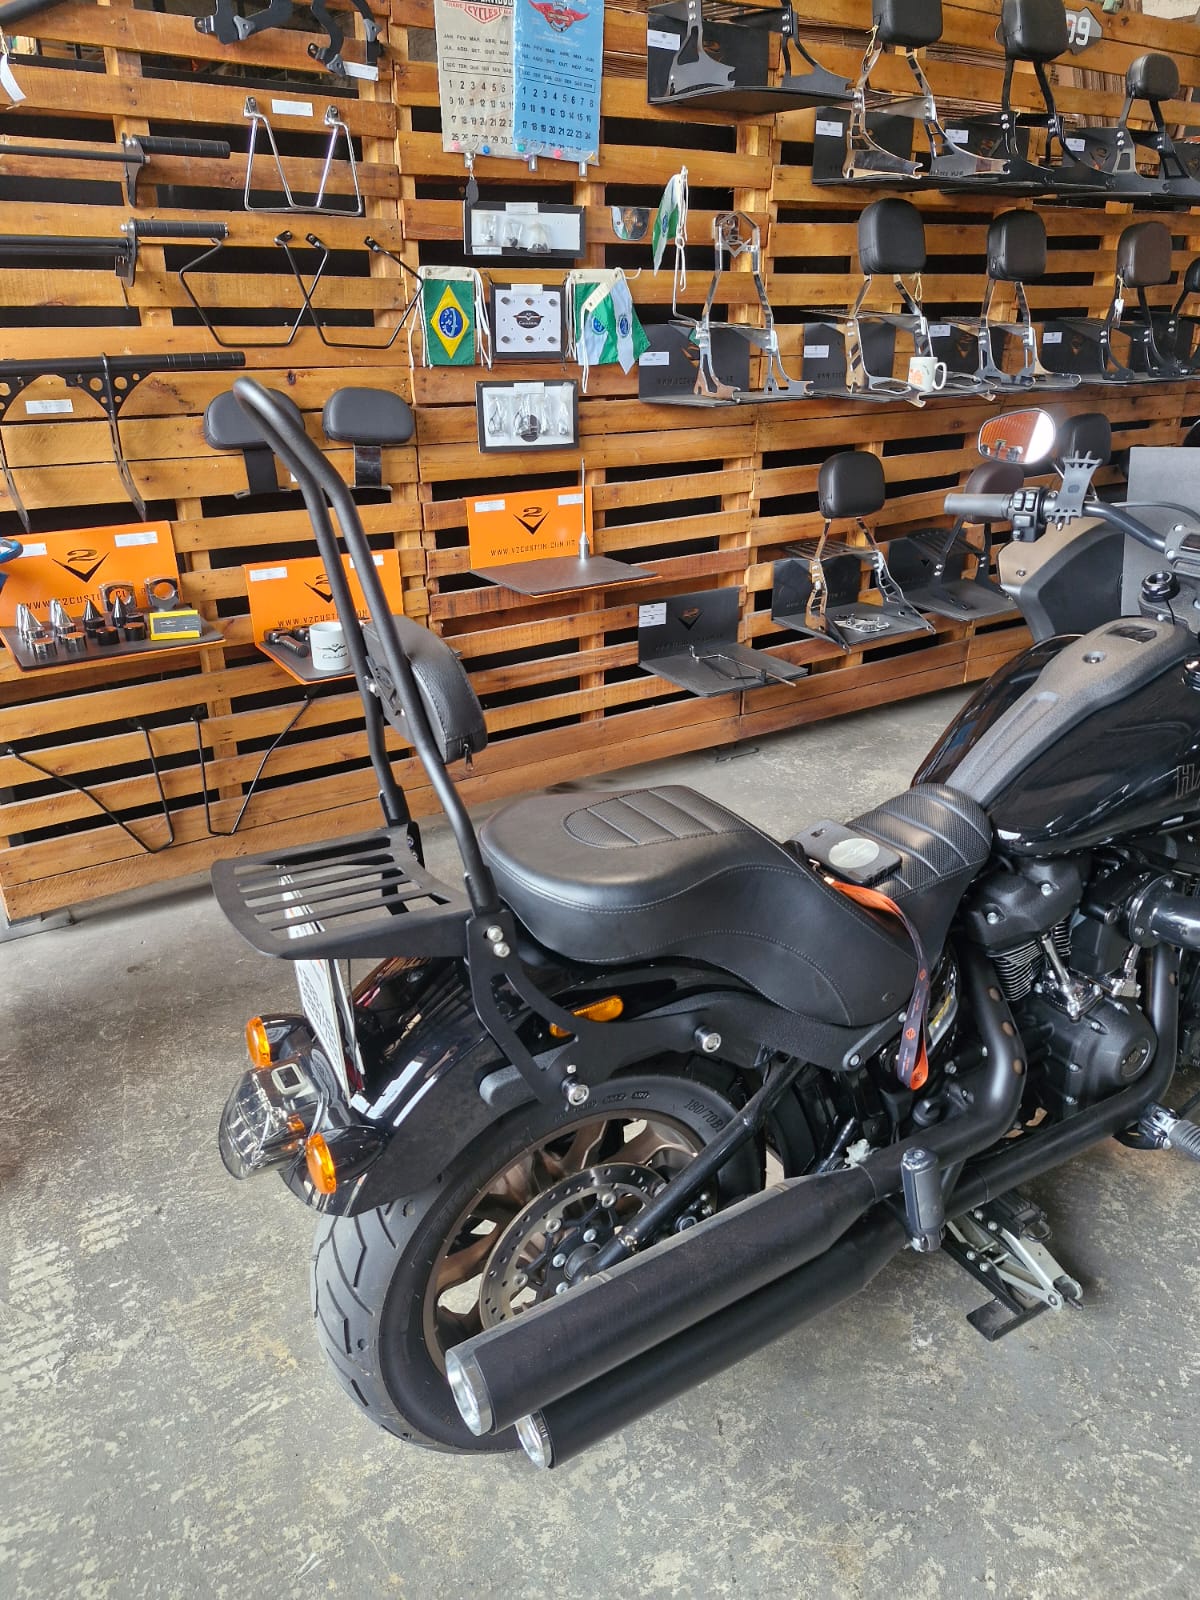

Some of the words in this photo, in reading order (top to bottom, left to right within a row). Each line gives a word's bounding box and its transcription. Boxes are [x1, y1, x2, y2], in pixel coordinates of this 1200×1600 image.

[490, 118, 497, 127] 21
[499, 119, 506, 127] 22
[531, 122, 538, 131] 18
[541, 124, 547, 132] 19
[549, 125, 556, 134] 20
[558, 127, 565, 135] 21
[566, 128, 573, 137] 22
[575, 130, 582, 138] 23
[451, 133, 459, 141] 25
[501, 136, 508, 144] 30
